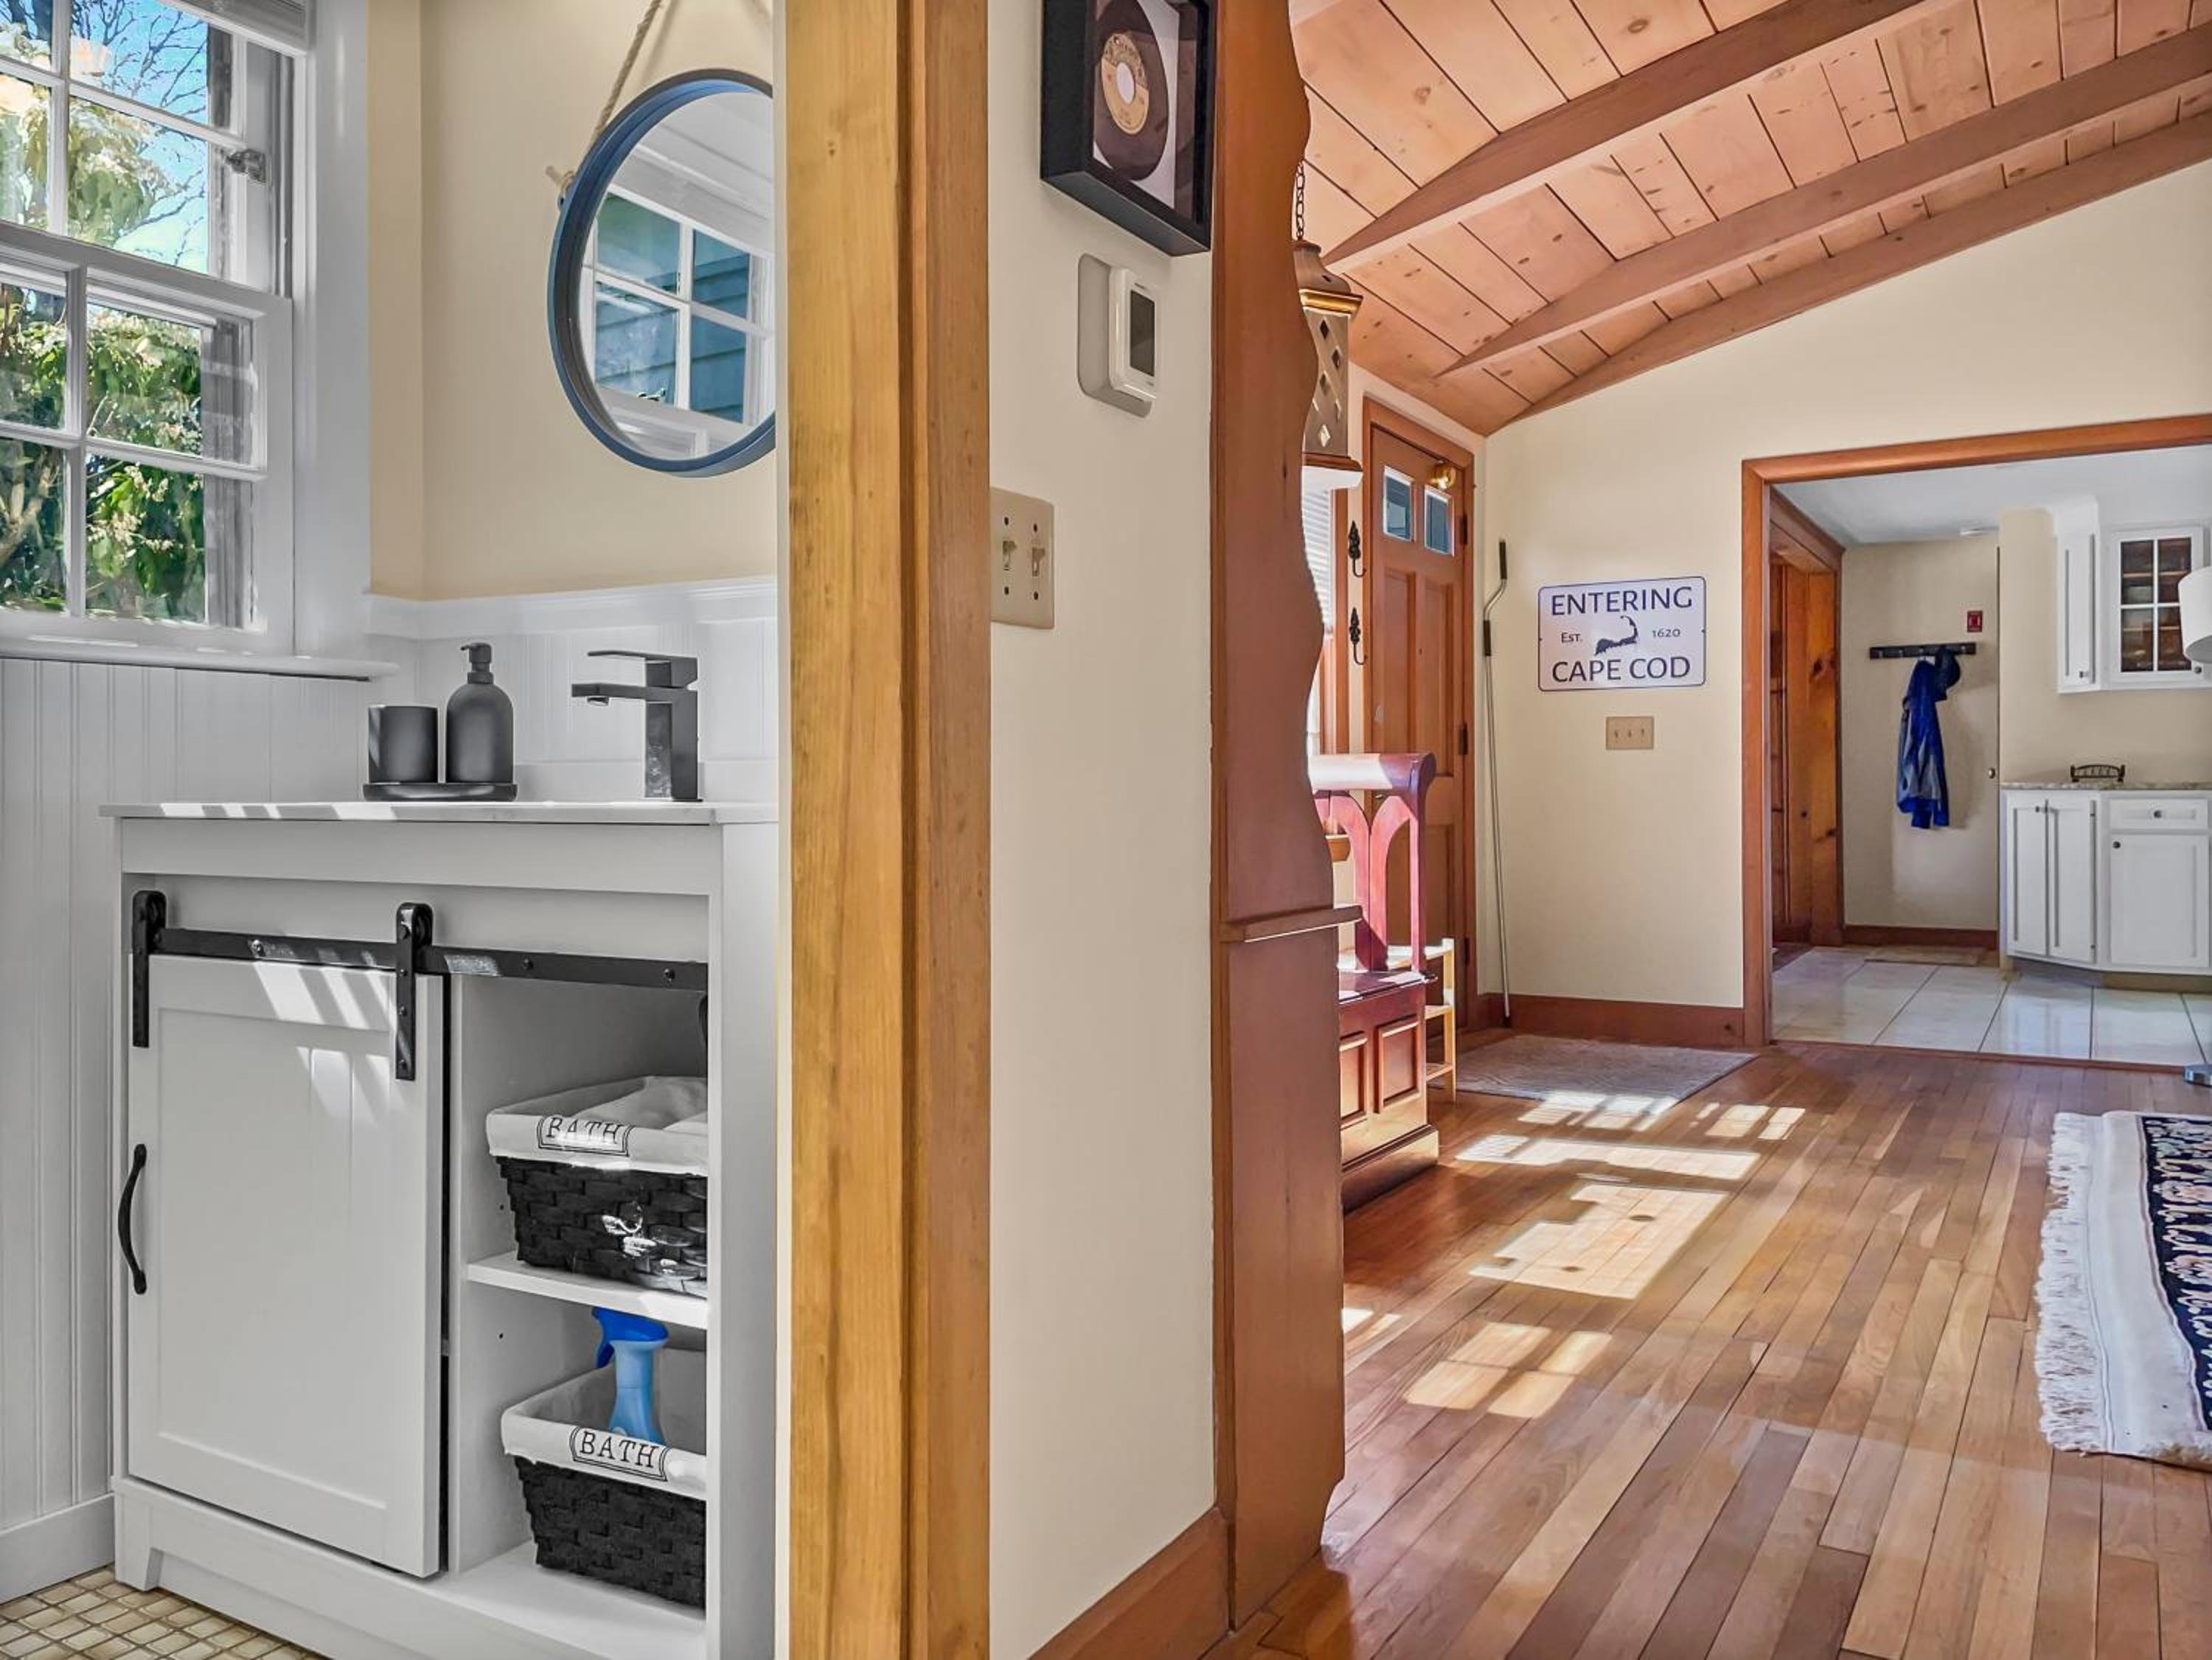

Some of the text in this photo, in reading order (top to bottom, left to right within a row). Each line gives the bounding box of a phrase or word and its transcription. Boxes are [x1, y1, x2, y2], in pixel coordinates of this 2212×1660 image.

[1551, 587, 1692, 615] ENTERING
[1652, 628, 1680, 638] 1620
[1552, 656, 1690, 682] CAPE COD
[546, 1117, 623, 1144] BATH
[580, 1431, 658, 1467] BATH
